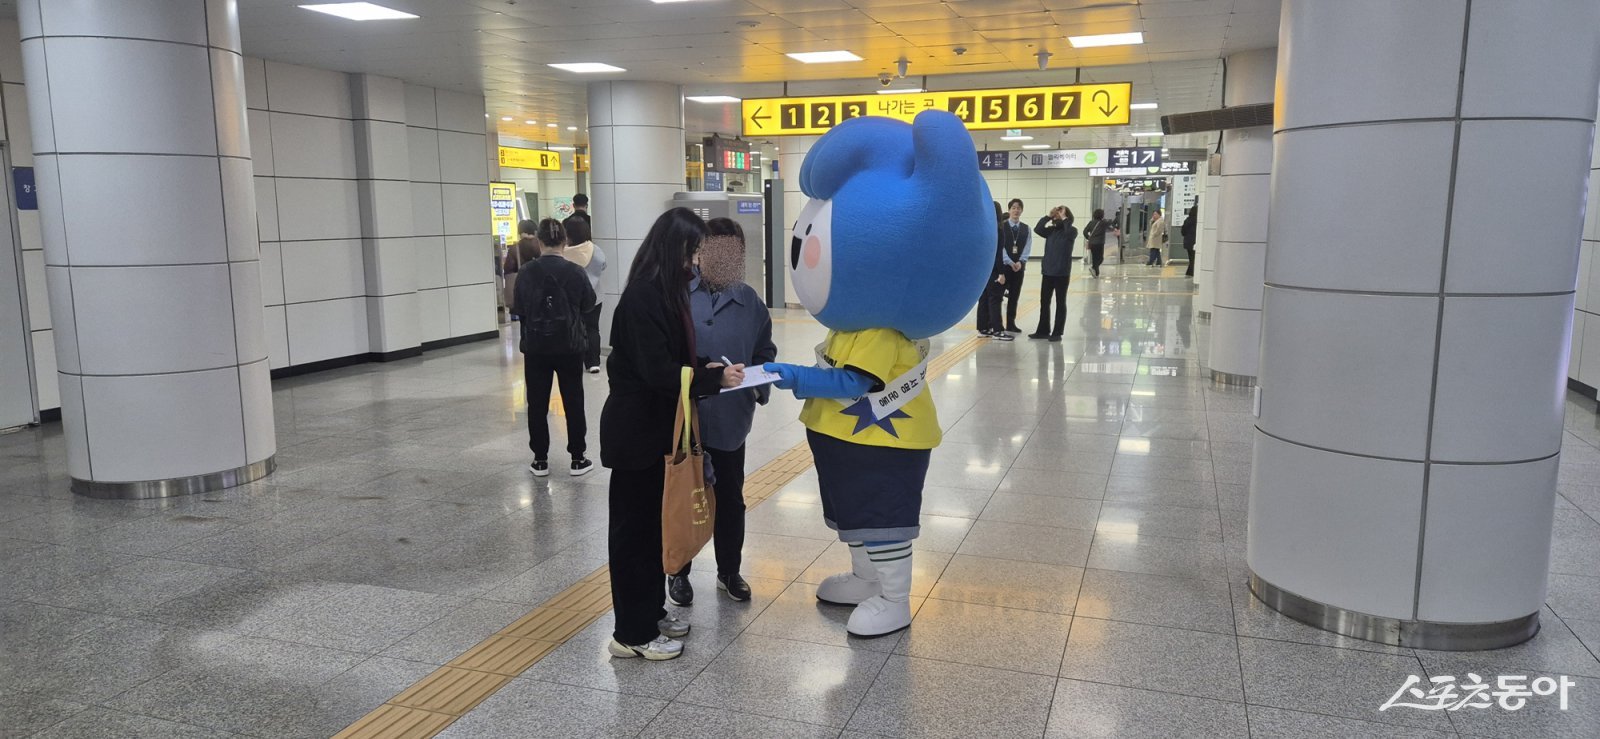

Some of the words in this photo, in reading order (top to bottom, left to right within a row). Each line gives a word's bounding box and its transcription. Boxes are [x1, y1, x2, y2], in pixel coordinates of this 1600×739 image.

[788, 107, 797, 126] 1
[817, 105, 830, 126] 2
[849, 104, 861, 118] 3
[878, 100, 916, 115] 나가는
[954, 100, 969, 120] 4
[989, 99, 1003, 119] 5
[1023, 97, 1039, 117] 6
[1060, 96, 1075, 116] 7
[982, 154, 992, 167] 4
[1131, 150, 1138, 164] 1
